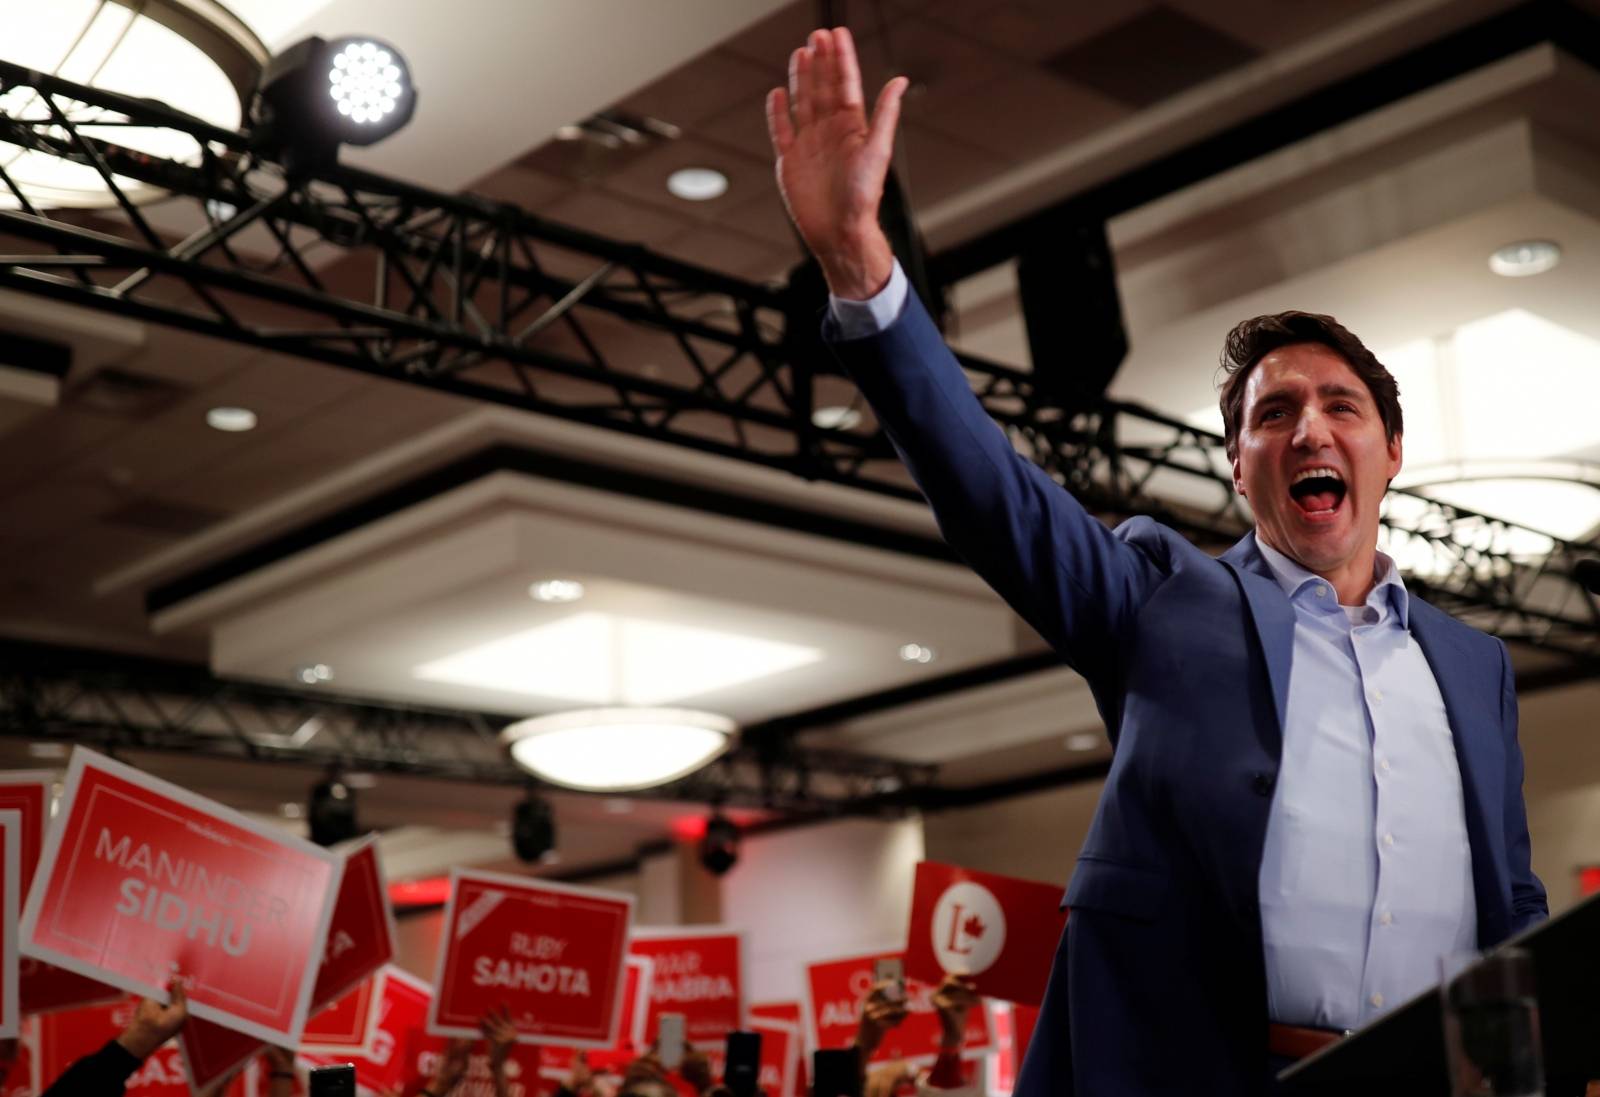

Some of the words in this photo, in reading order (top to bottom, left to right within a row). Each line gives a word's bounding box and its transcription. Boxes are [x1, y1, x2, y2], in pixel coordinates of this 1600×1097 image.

[95, 827, 289, 927] MANINDER
[115, 876, 252, 958] SIDHU
[509, 930, 569, 961] RUBY
[472, 954, 591, 997] SAHOTA
